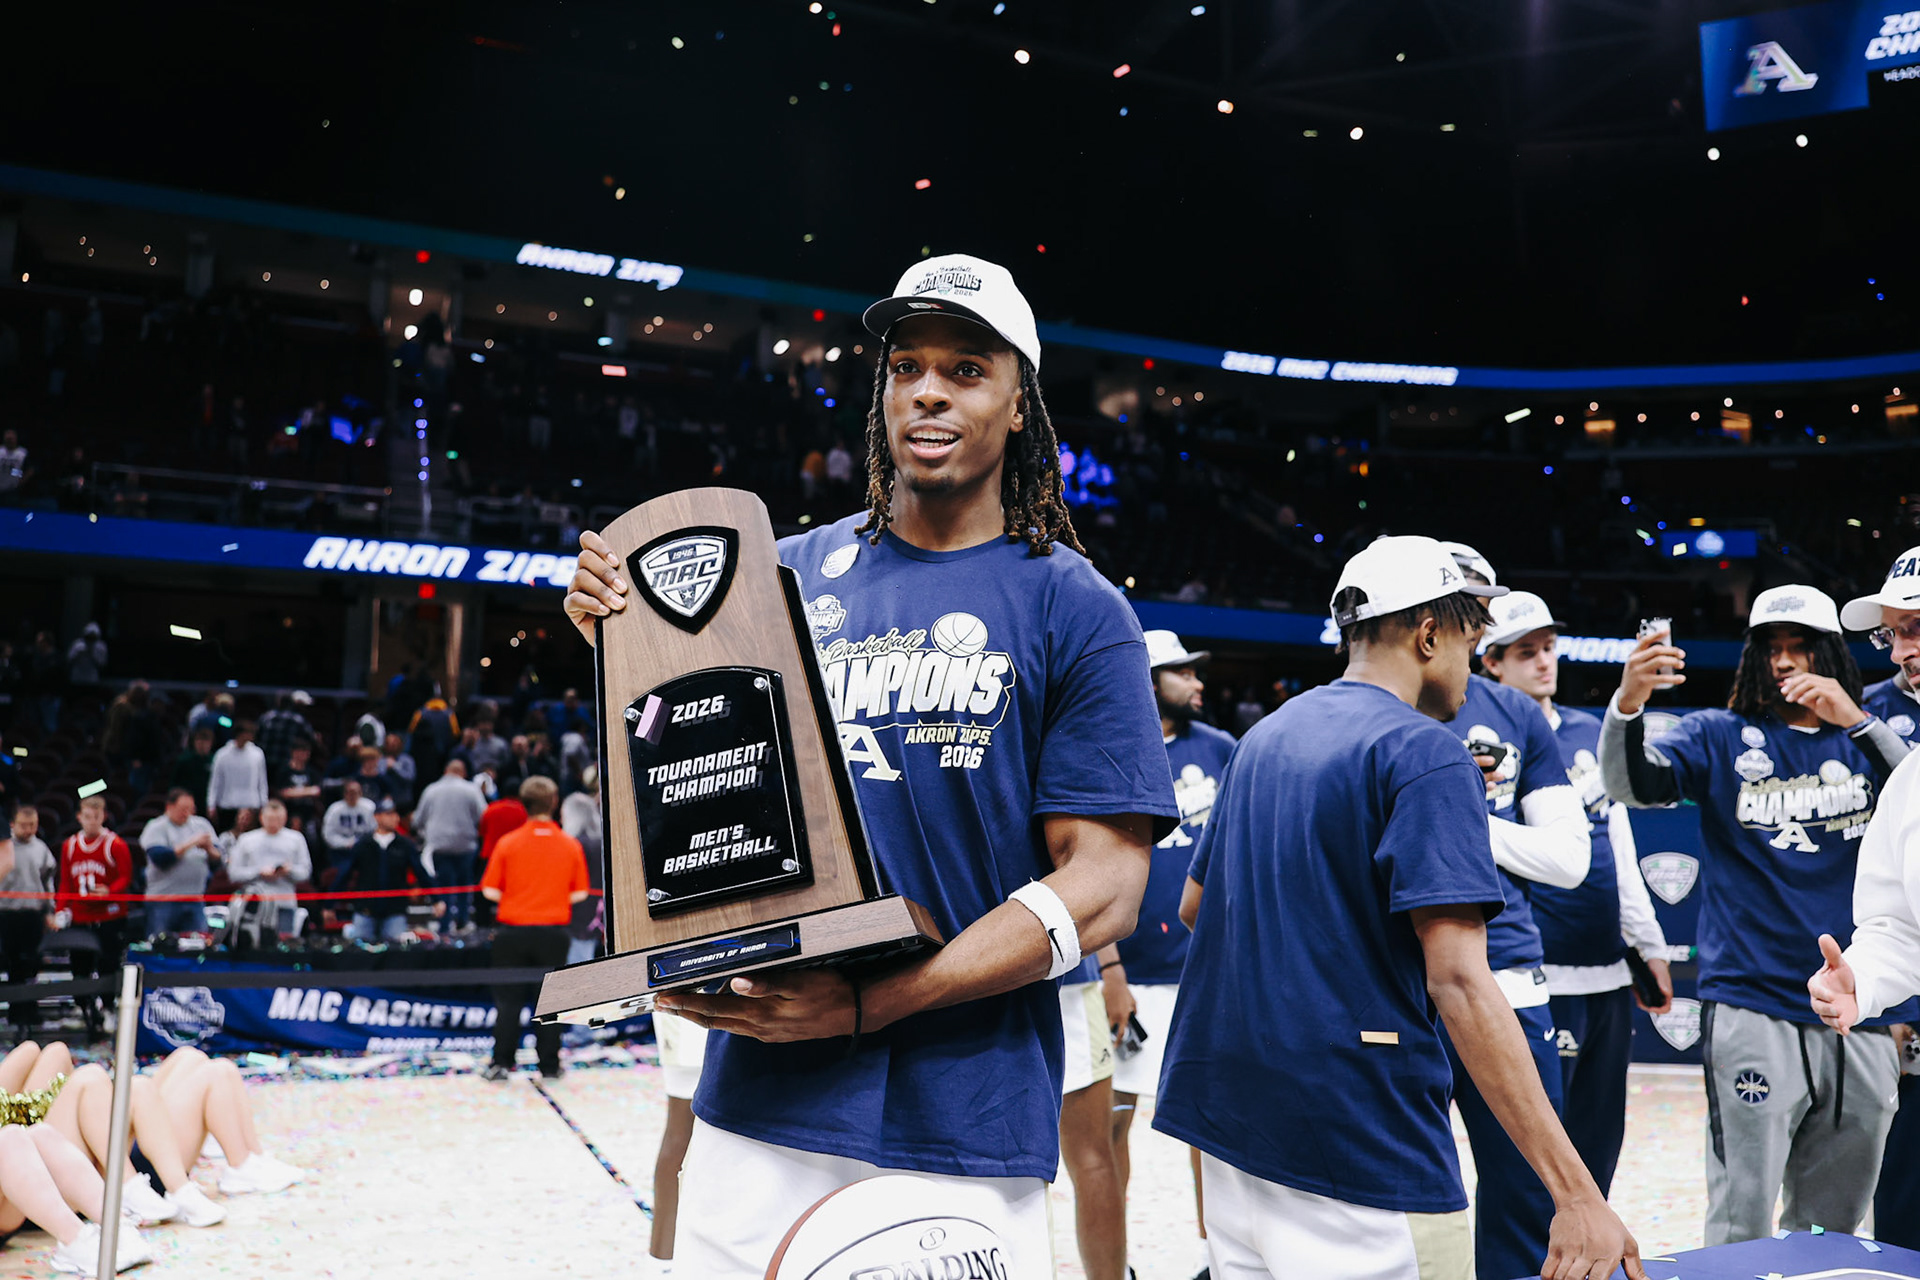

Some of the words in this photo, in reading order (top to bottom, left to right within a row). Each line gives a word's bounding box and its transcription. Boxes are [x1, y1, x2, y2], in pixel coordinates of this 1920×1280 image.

[1879, 10, 1920, 37] 20
[912, 272, 982, 296] CHAMPIONS
[303, 536, 470, 579] AKRON
[672, 547, 694, 560] 1946
[650, 557, 721, 588] MAC
[1440, 567, 1458, 586] A
[823, 650, 1011, 723] AMPIONS
[671, 694, 726, 724] 2026
[904, 726, 957, 745] AKRON
[647, 741, 768, 786] TOURNAMENT
[661, 765, 758, 804] CHAMPION
[1736, 774, 1868, 826] CHAMPIONS
[689, 823, 745, 851] MEN'S
[1768, 821, 1821, 853] A
[662, 835, 775, 875] BASKETBALL
[679, 951, 725, 968] UNIVERSITY
[727, 949, 739, 958] OF
[740, 942, 768, 955] AKRON
[268, 987, 344, 1023] MAC
